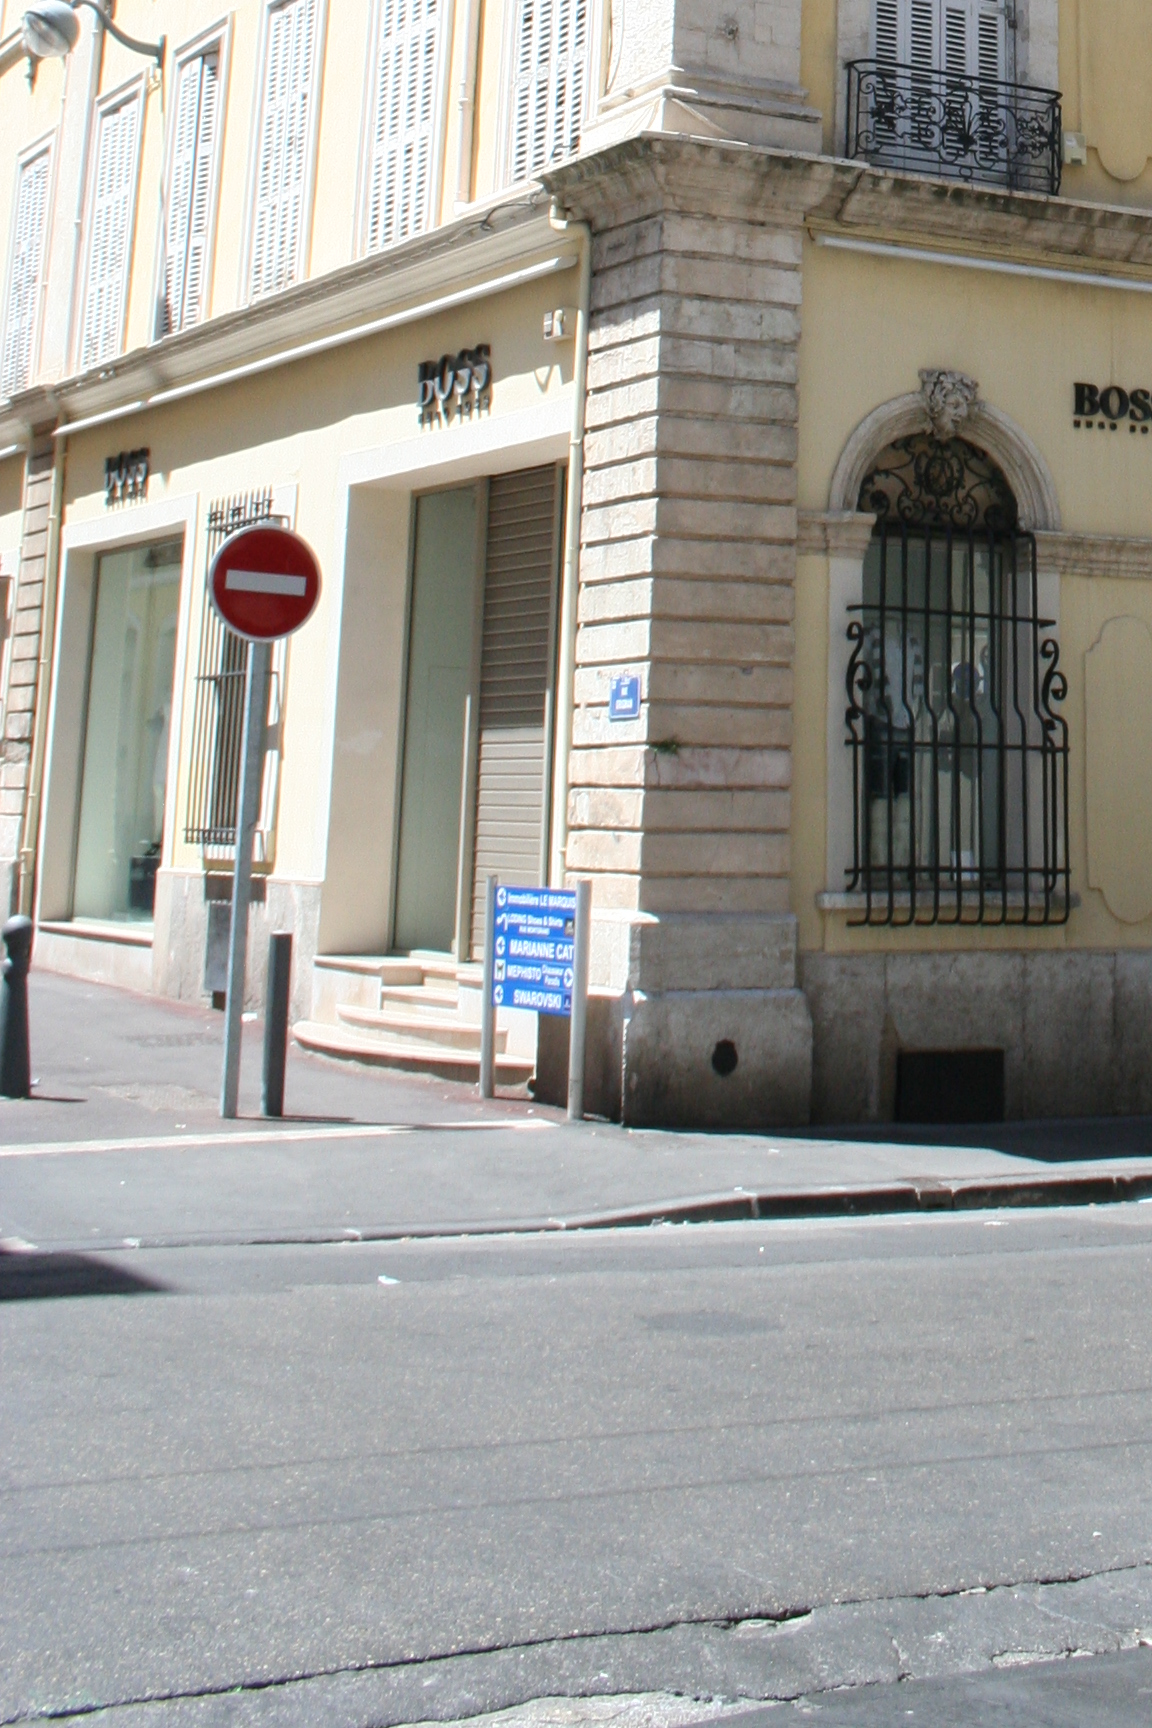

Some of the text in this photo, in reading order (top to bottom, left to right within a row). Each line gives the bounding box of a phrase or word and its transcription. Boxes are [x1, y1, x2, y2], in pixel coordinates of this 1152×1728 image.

[418, 343, 492, 407] BOSS
[540, 894, 548, 907] LE
[510, 939, 574, 961] MARIANNE CAT
[507, 964, 542, 981] MEPHISTO
[514, 989, 562, 1009] SWAROVSKI
